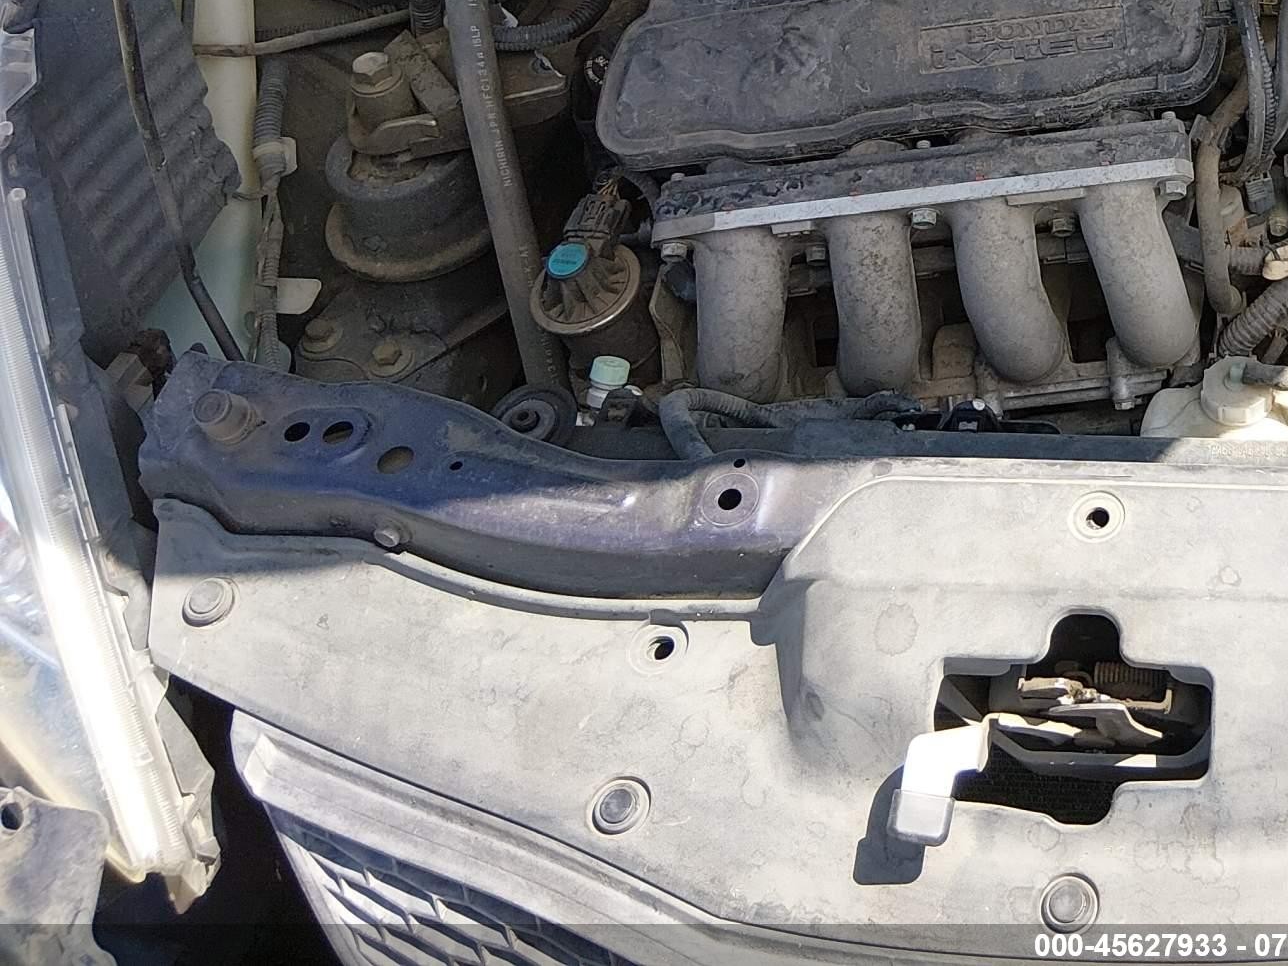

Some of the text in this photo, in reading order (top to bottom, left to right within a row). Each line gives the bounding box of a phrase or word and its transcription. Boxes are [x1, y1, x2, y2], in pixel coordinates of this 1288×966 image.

[967, 16, 1099, 44] HONDA
[929, 33, 1115, 70] i-VTEC
[495, 137, 513, 187] NICHIRIN
